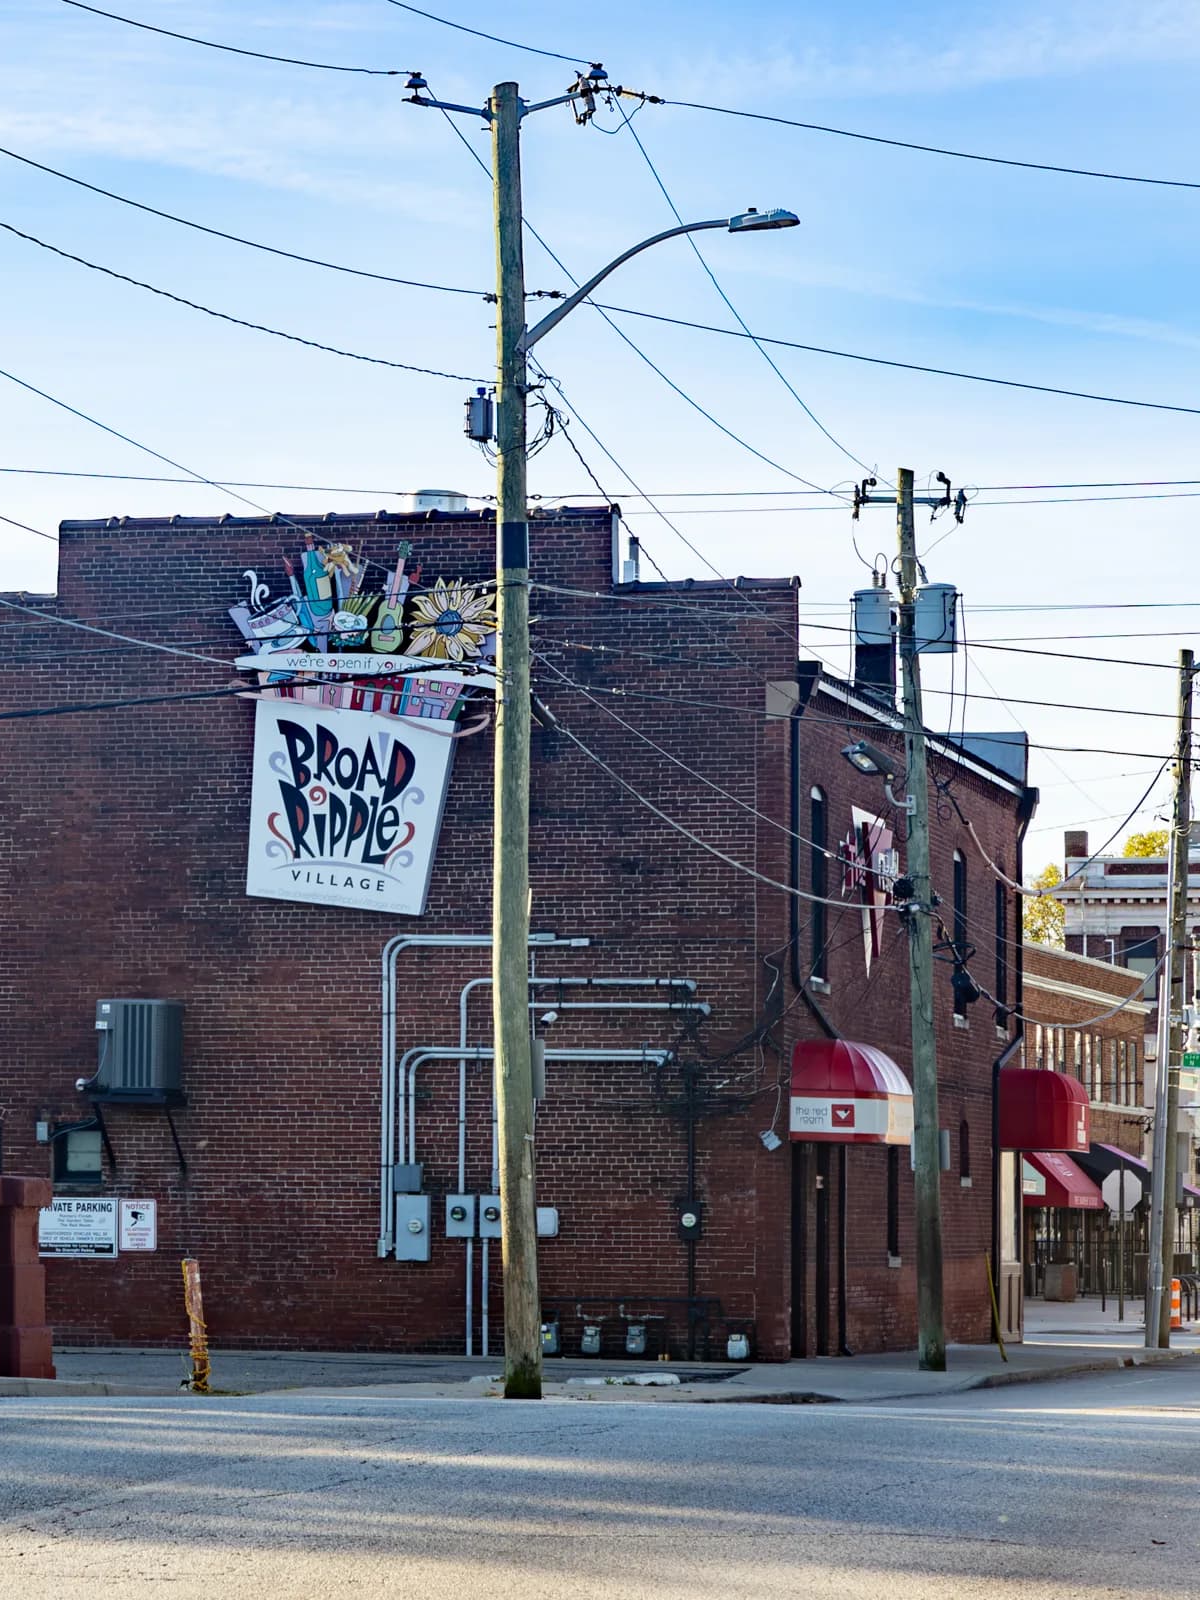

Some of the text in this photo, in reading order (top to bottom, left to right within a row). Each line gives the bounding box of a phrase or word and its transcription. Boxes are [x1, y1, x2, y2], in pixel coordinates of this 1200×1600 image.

[287, 655, 324, 667] we're
[327, 659, 361, 670] open
[364, 657, 374, 669] if
[377, 661, 402, 673] you
[276, 719, 416, 805] BROAD
[291, 870, 385, 892] VILLAGE
[795, 1106, 827, 1116] the red
[800, 1116, 824, 1125] room
[44, 1202, 113, 1213] IVATE PARKING
